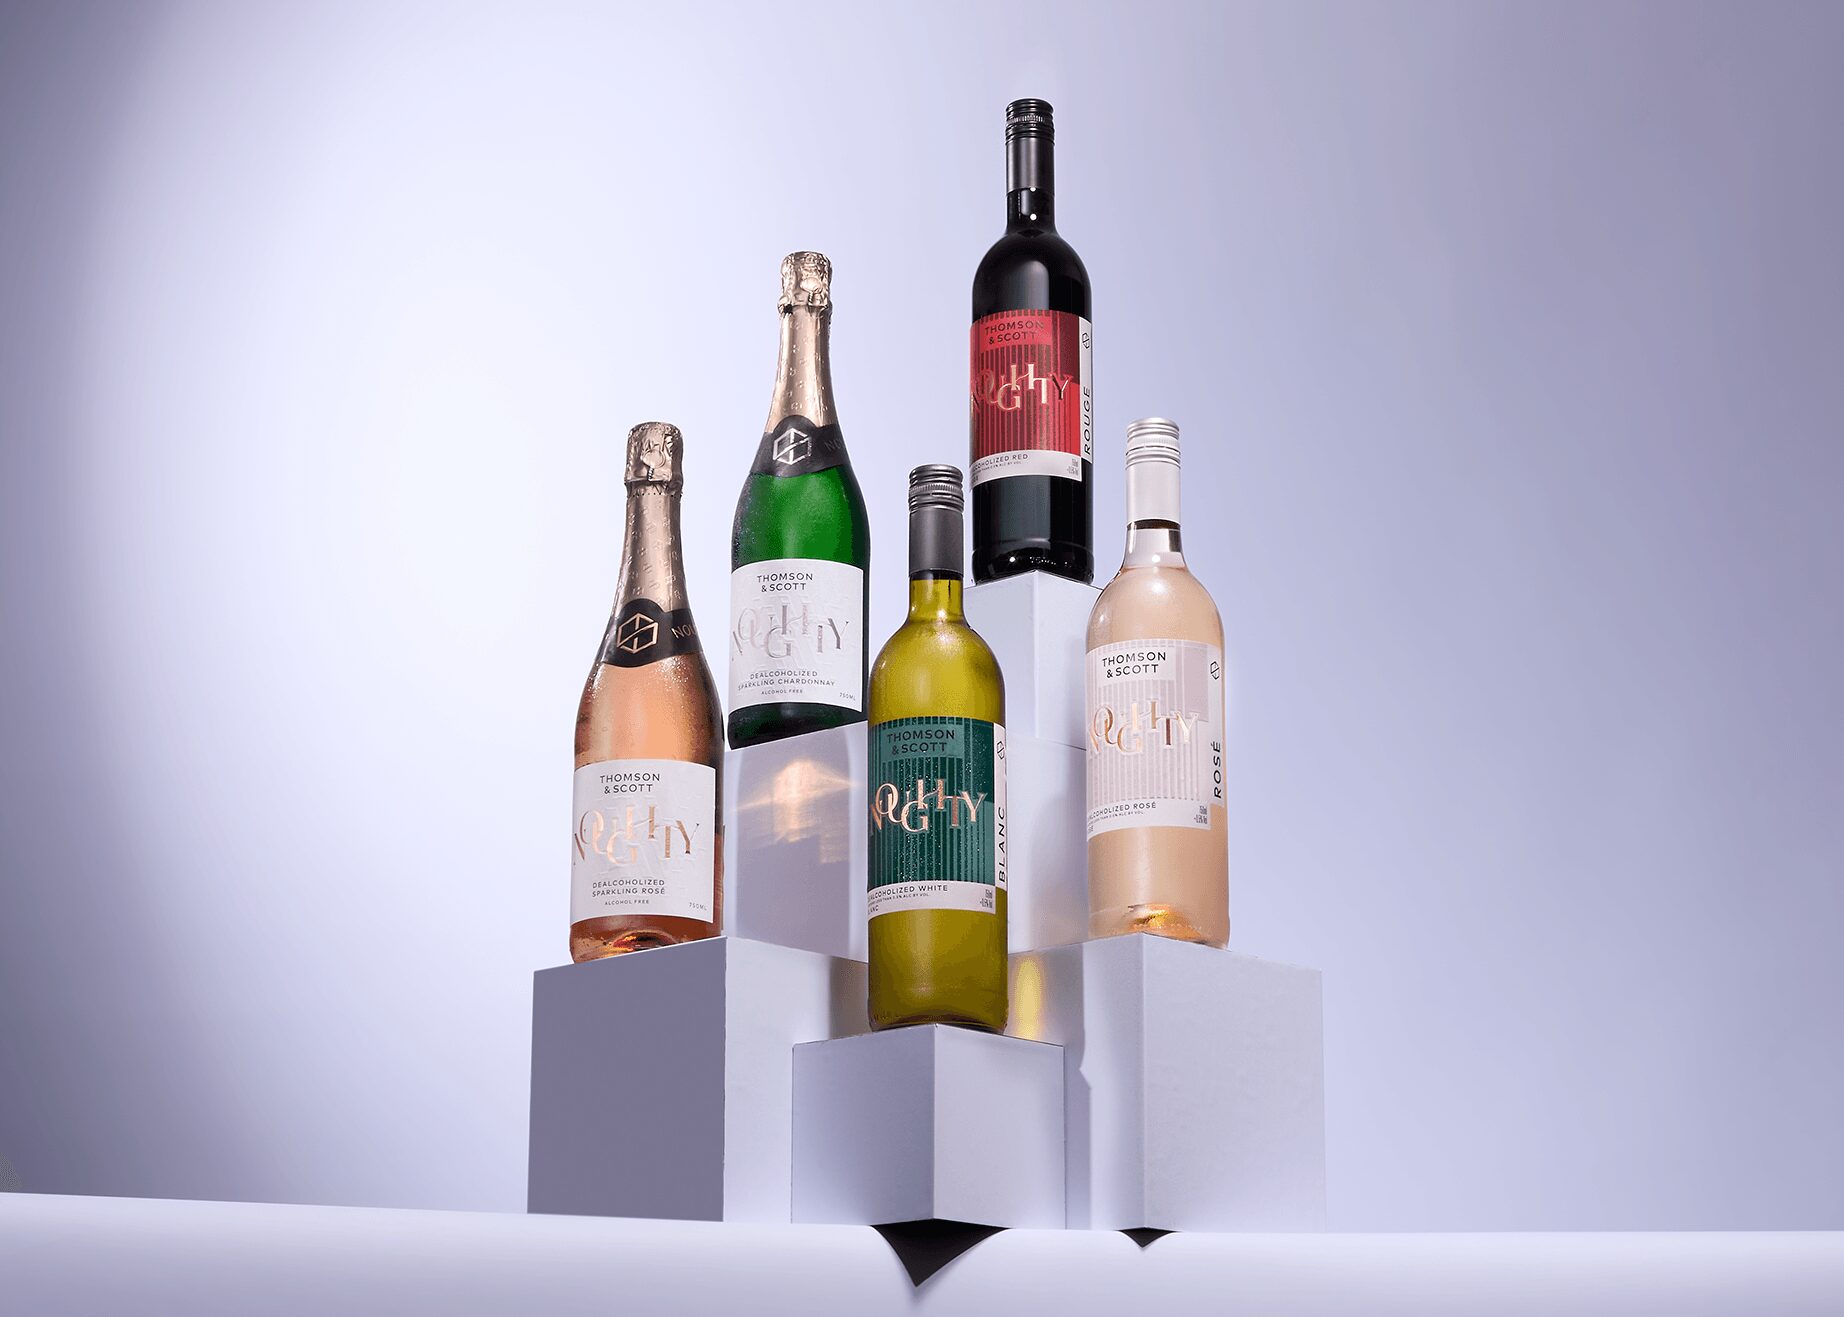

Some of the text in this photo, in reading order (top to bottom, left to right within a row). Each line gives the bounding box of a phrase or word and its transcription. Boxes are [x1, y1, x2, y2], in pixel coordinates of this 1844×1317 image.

[984, 320, 1044, 335] THOMSON
[988, 331, 1037, 345] & SCOTT
[1083, 386, 1091, 456] ROUGE
[757, 572, 814, 583] THOMSON
[769, 583, 806, 592] SCOTT
[1102, 651, 1166, 667] THOMSON
[750, 670, 818, 680] DEALCOHOLIZED
[1106, 664, 1159, 678] & SCOTT
[738, 678, 835, 691] SPARKLING CHARDONNAY
[887, 729, 955, 743] THOMSON
[891, 742, 947, 755] & SCOTT
[1210, 741, 1222, 799] ROSÉ
[600, 772, 660, 784] THOMSON
[604, 783, 653, 794] & SCOTT
[1133, 801, 1157, 809] ROSÉ
[998, 807, 1006, 883] BLANC
[592, 879, 665, 888] DEALCOHOLIZED
[592, 886, 665, 897] SPARKLING ROSÉ
[688, 902, 707, 911] 750ML
